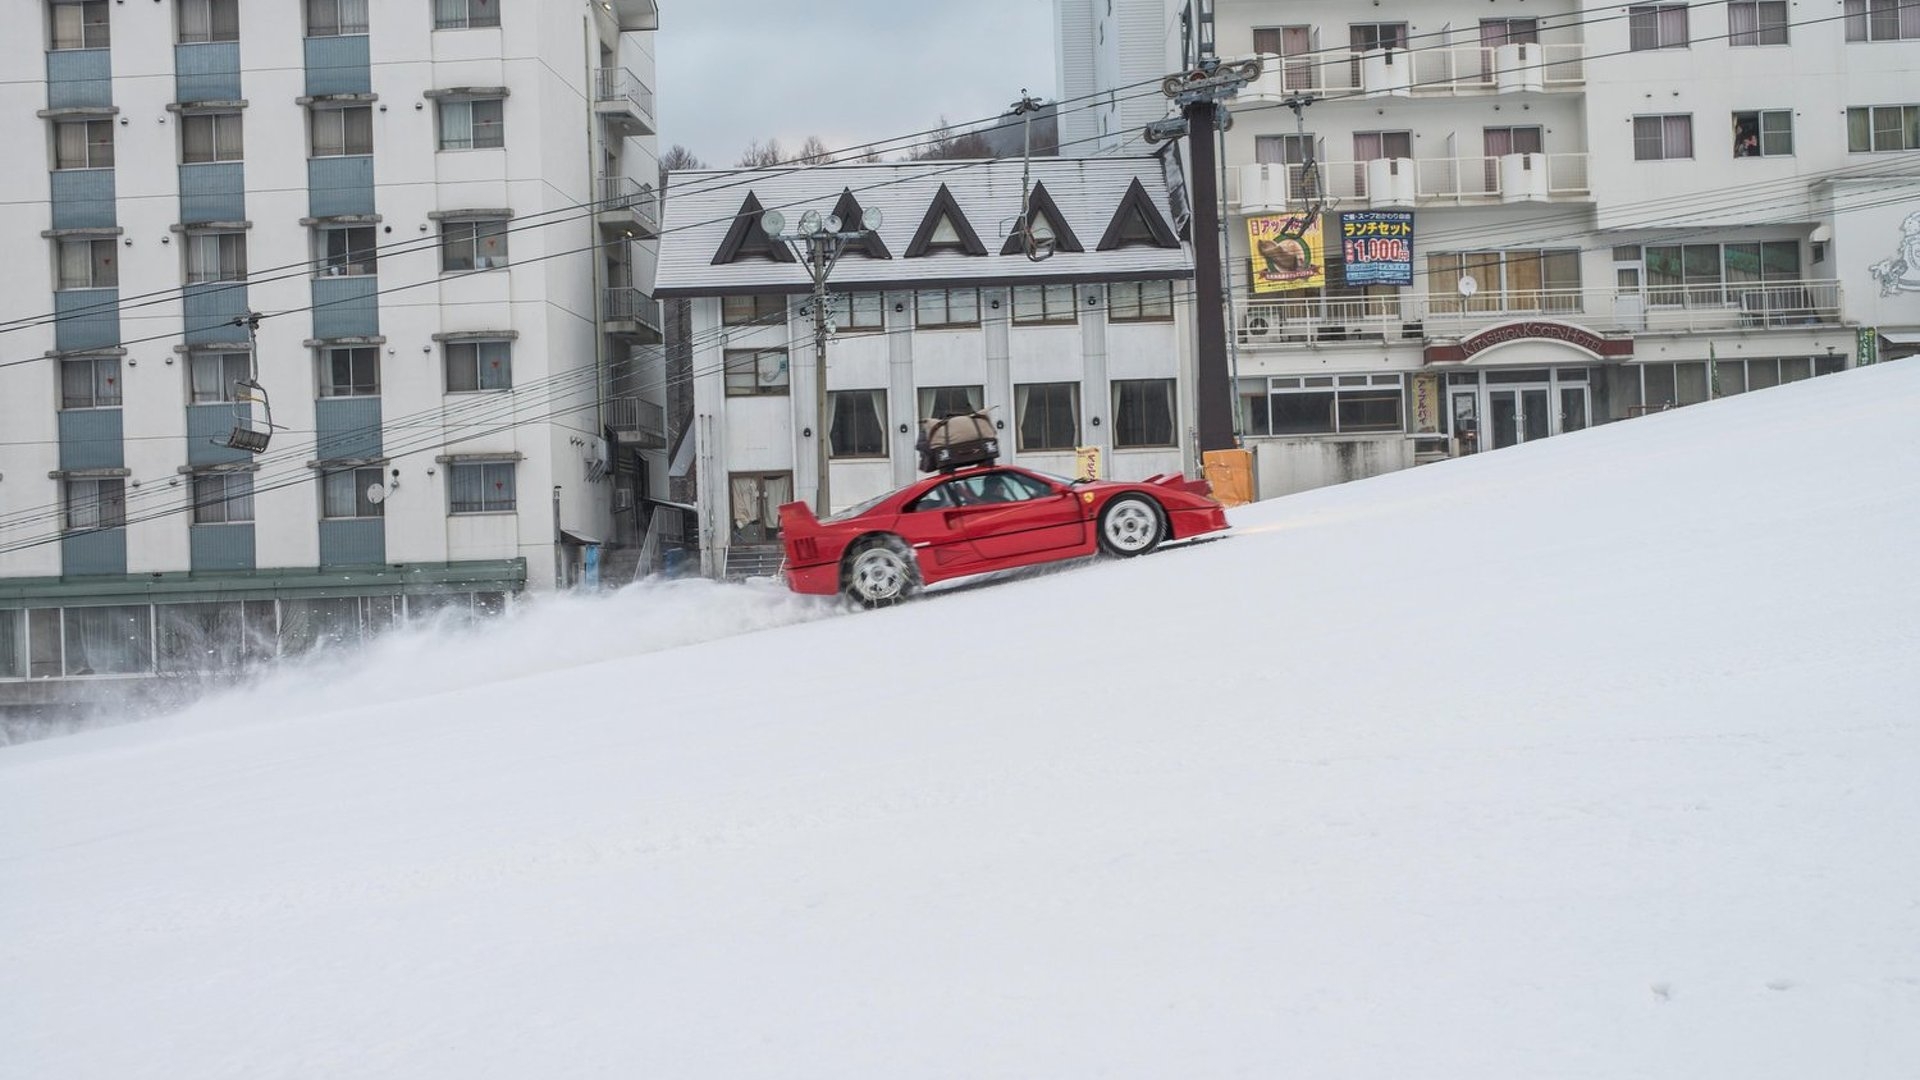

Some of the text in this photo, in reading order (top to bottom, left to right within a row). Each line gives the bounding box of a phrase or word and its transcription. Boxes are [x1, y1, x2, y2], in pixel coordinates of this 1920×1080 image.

[1344, 222, 1411, 236] ランチセット
[1522, 323, 1565, 339] KOGEN
[1566, 326, 1601, 352] HOTEL
